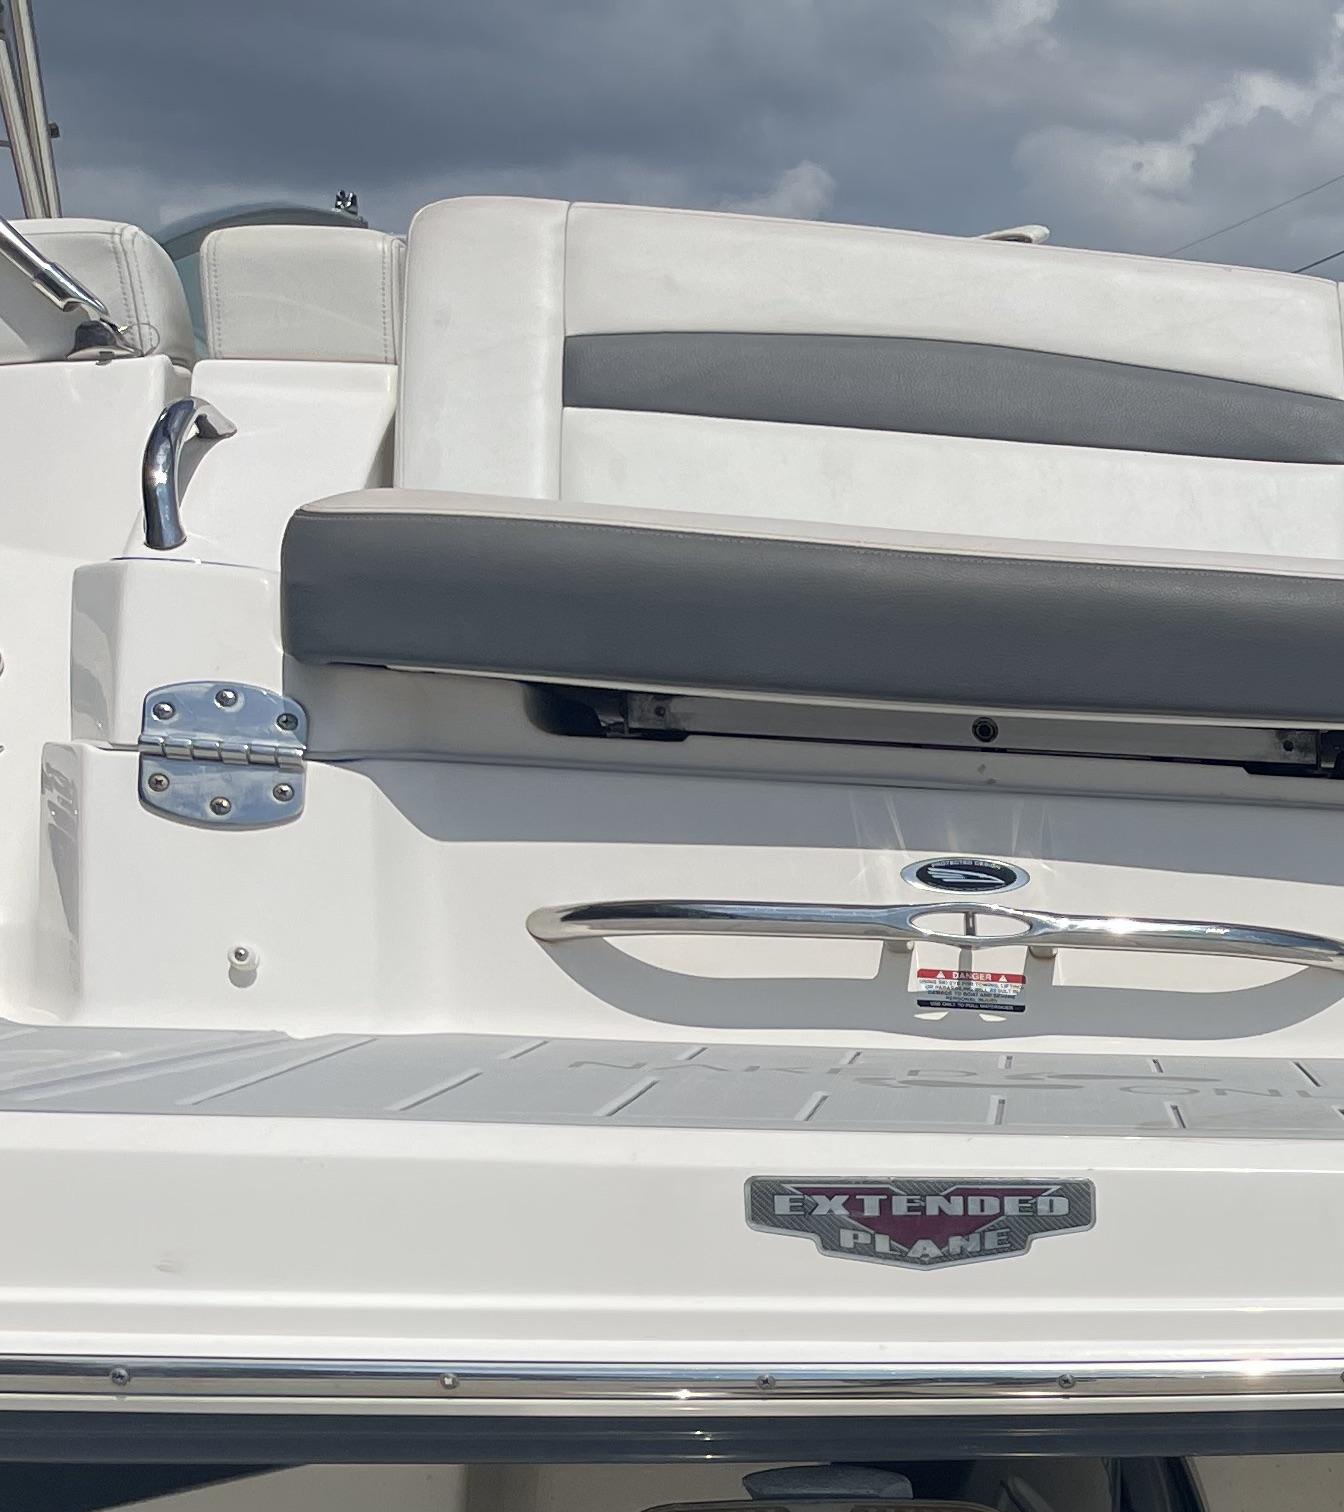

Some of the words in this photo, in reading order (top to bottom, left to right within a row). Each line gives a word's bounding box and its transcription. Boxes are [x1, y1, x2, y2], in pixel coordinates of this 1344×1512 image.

[952, 971, 992, 981] DANGER
[774, 1194, 1069, 1216] EXTENDED
[839, 1228, 1012, 1259] PLANE
